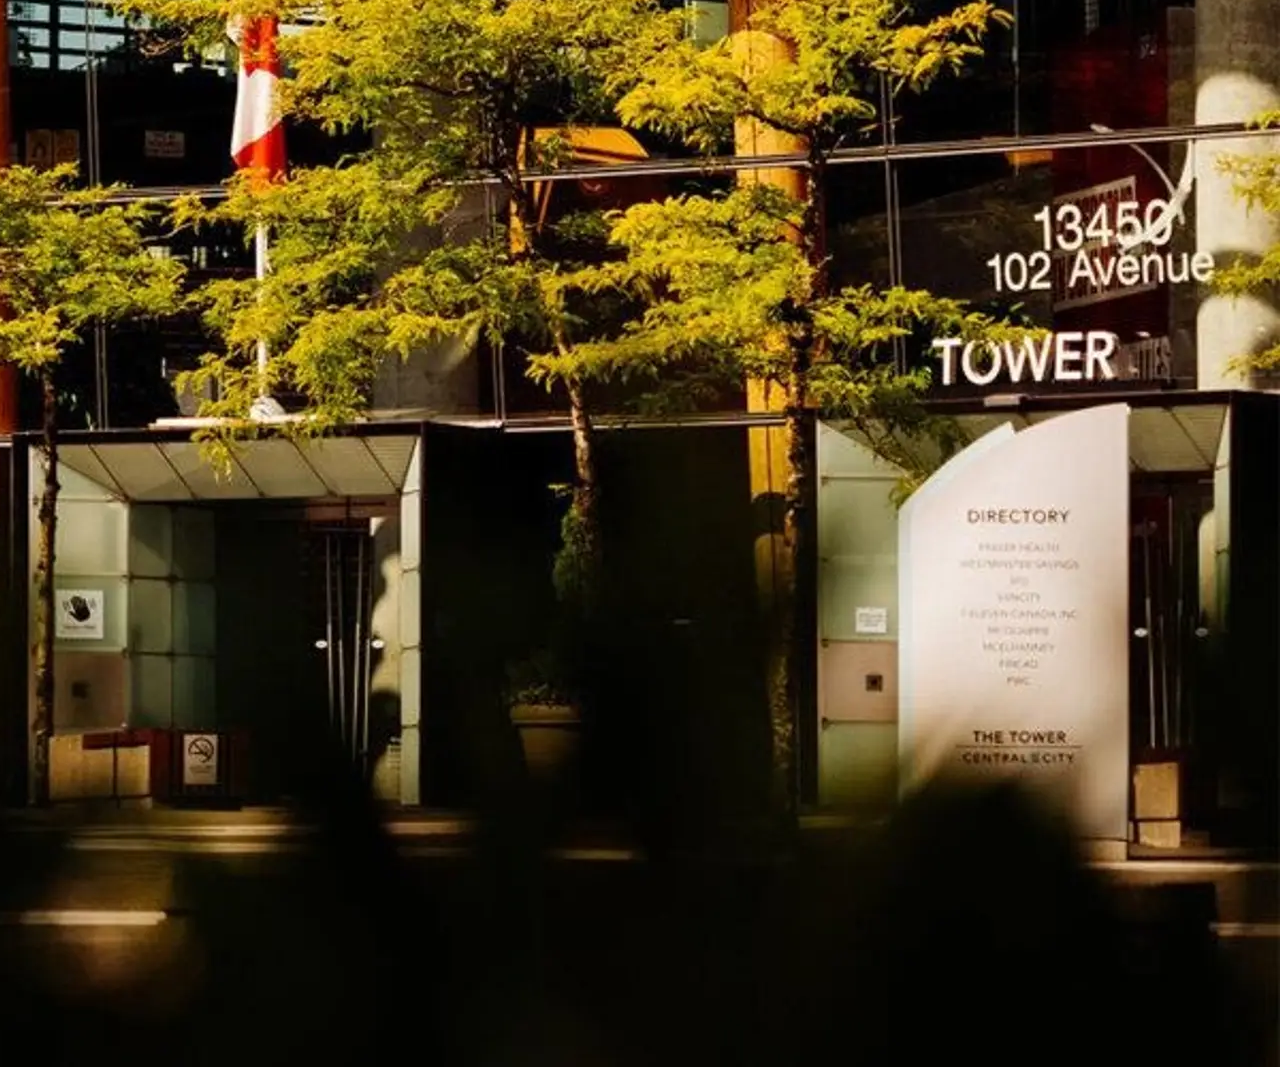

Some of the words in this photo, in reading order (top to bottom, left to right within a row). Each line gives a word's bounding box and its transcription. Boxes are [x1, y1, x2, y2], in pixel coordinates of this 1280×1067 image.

[1034, 198, 1173, 251] 13450
[986, 252, 1052, 292] 102
[1068, 248, 1215, 288] Avenue
[932, 330, 1119, 386] TOWER
[966, 509, 1071, 524] DIRECTORY
[972, 730, 1004, 744] THE
[1009, 730, 1067, 744] TOWER
[961, 752, 1028, 764] CENTRAL
[1041, 752, 1075, 764] CITY
